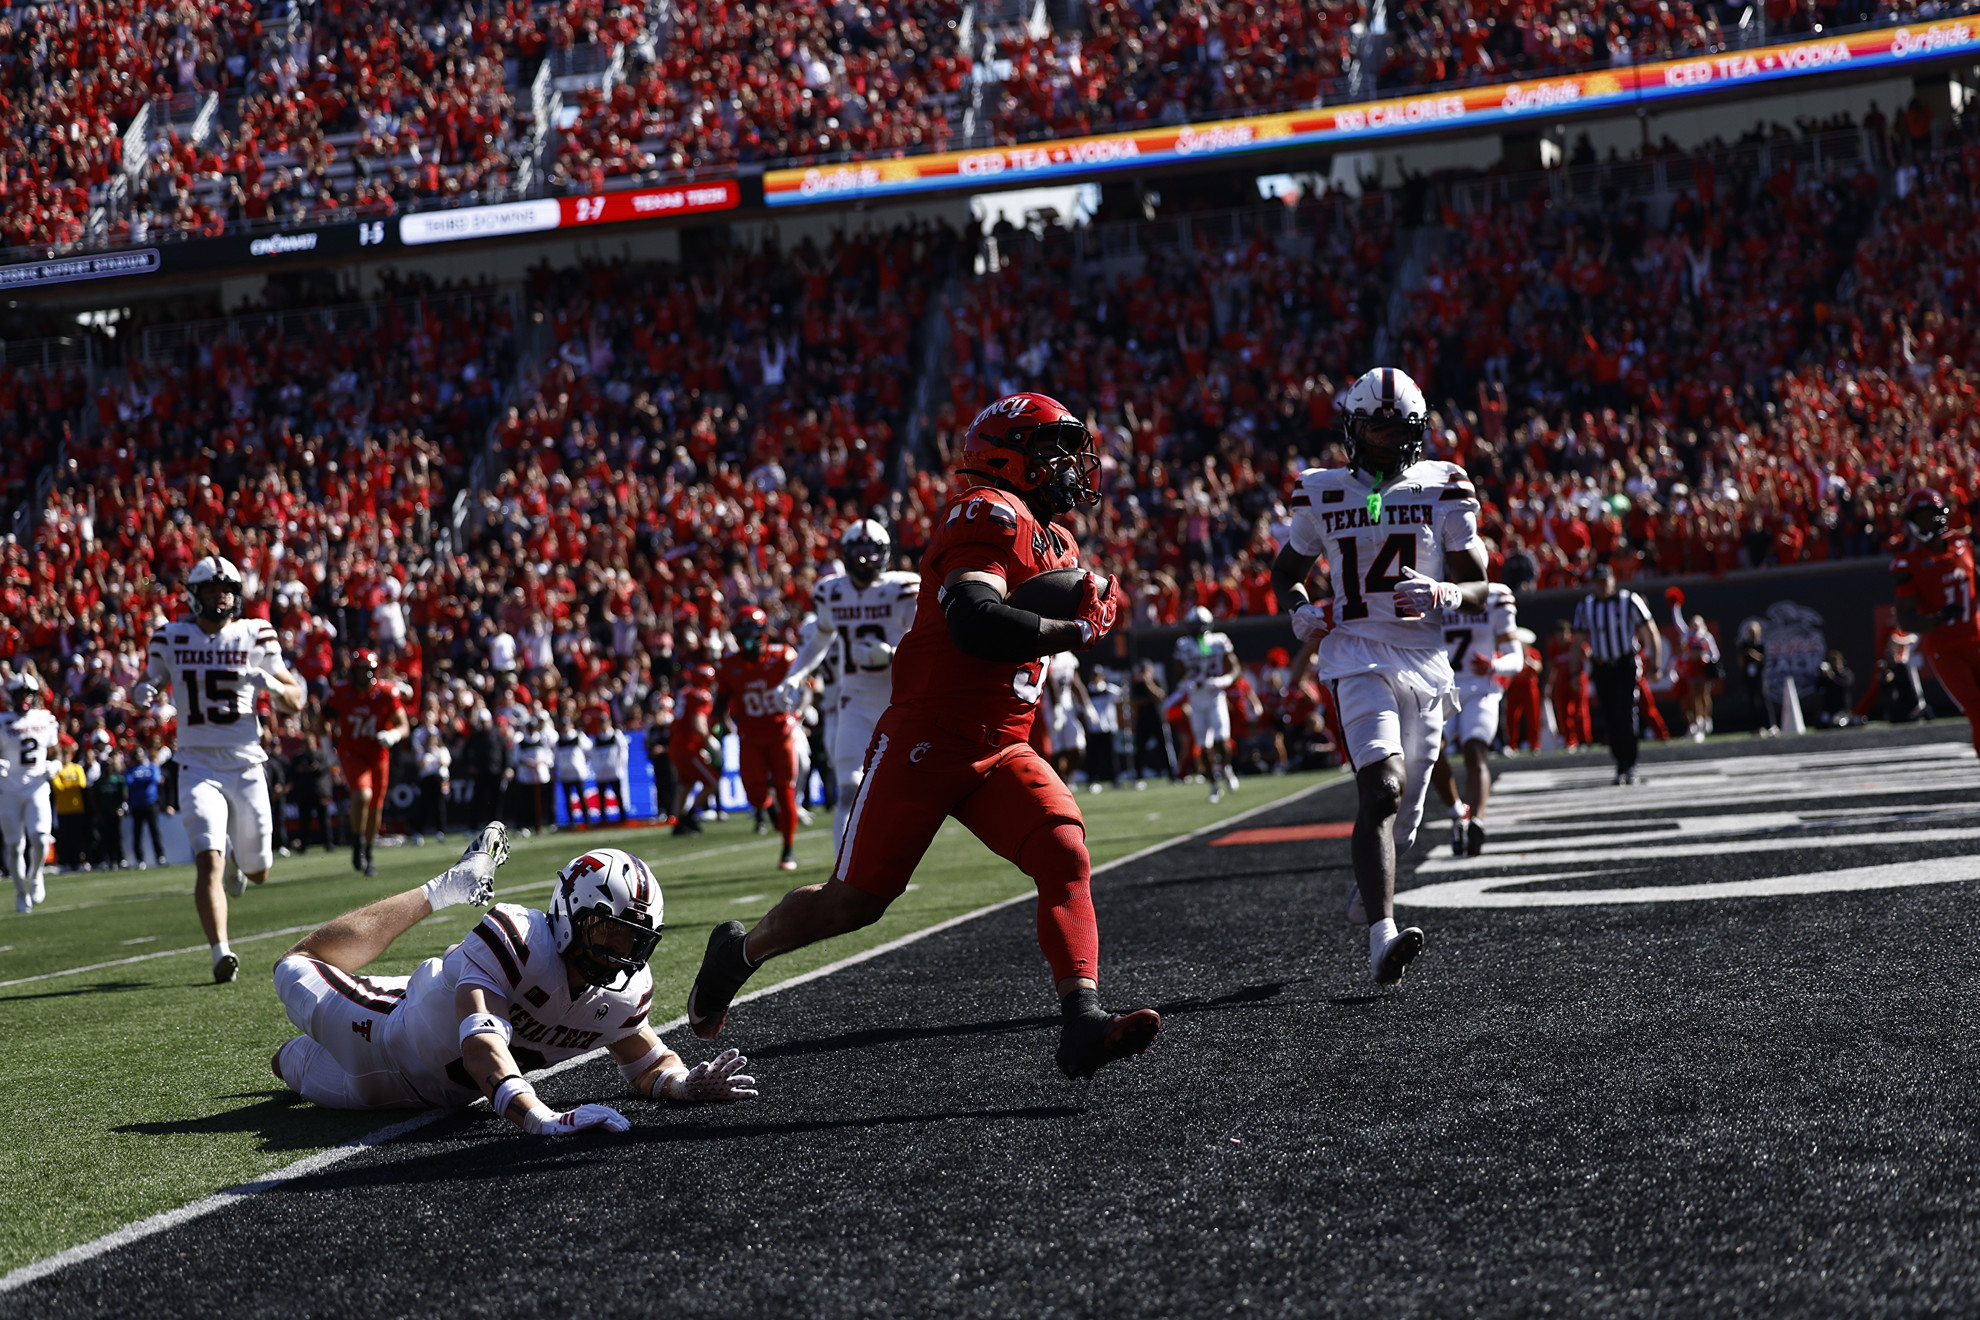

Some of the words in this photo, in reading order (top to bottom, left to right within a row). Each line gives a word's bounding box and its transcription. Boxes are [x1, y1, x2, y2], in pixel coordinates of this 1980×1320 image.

[1664, 61, 1712, 87] ICED
[1716, 55, 1760, 80] TEA
[1778, 41, 1851, 71] VODKA
[1367, 95, 1466, 128] CALORIES
[957, 152, 1006, 177] ICED
[1008, 147, 1051, 171] TEA
[1068, 137, 1141, 164] VODKA
[1385, 504, 1433, 526] TECH
[1337, 533, 1417, 621] 14
[832, 606, 862, 621] TEXAS
[864, 604, 892, 620] TECH
[174, 650, 213, 664] TEXAS
[216, 650, 248, 665] TECH
[1444, 627, 1473, 672] 7
[182, 670, 241, 727] 15
[347, 714, 378, 739] 74
[20, 738, 38, 766] 2
[546, 1024, 604, 1050] TECH
